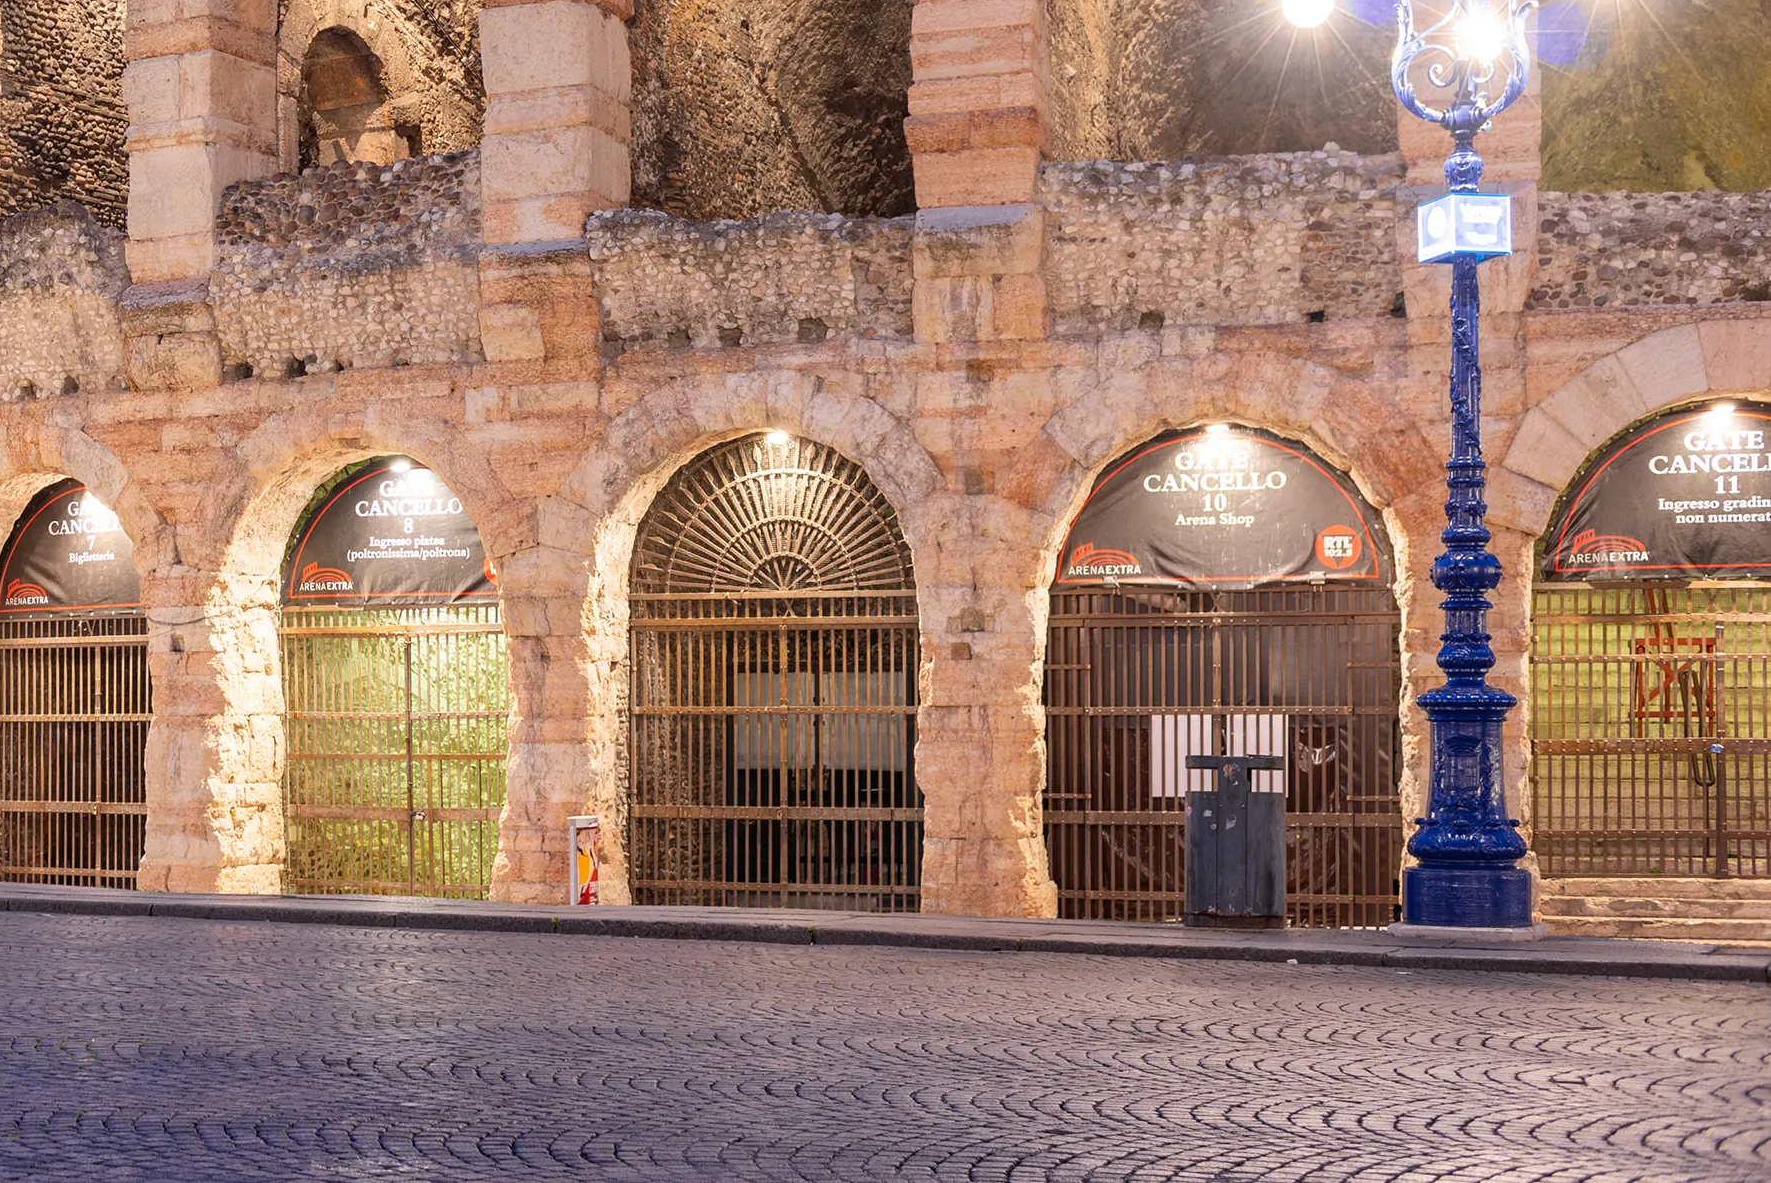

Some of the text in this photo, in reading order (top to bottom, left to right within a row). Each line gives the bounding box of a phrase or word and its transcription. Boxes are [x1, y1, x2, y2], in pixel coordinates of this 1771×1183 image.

[1683, 430, 1765, 452] GATE
[1174, 450, 1249, 471] GATE
[1143, 471, 1288, 493] CANCELLO
[1713, 475, 1741, 495] 11
[355, 497, 464, 517] CANCELLO
[1201, 493, 1228, 512] 10
[1657, 498, 1720, 512] Ingresso
[402, 517, 414, 534] 8
[1174, 512, 1256, 528] Arena Shop
[1675, 513, 1705, 524] non
[86, 534, 96, 551] 7
[369, 535, 446, 550] Ingresso platea
[1322, 535, 1352, 549] RTL
[68, 551, 116, 565] Biglietteria
[347, 546, 471, 562] (poltronissima/poltrona)
[1323, 548, 1353, 558] 102.5
[1568, 551, 1649, 564] ARENAEXTRA
[1067, 564, 1142, 575] ARENAEXTRA
[299, 582, 353, 591] ARENAEXTRA
[5, 596, 49, 606] ARENAEXTRA
